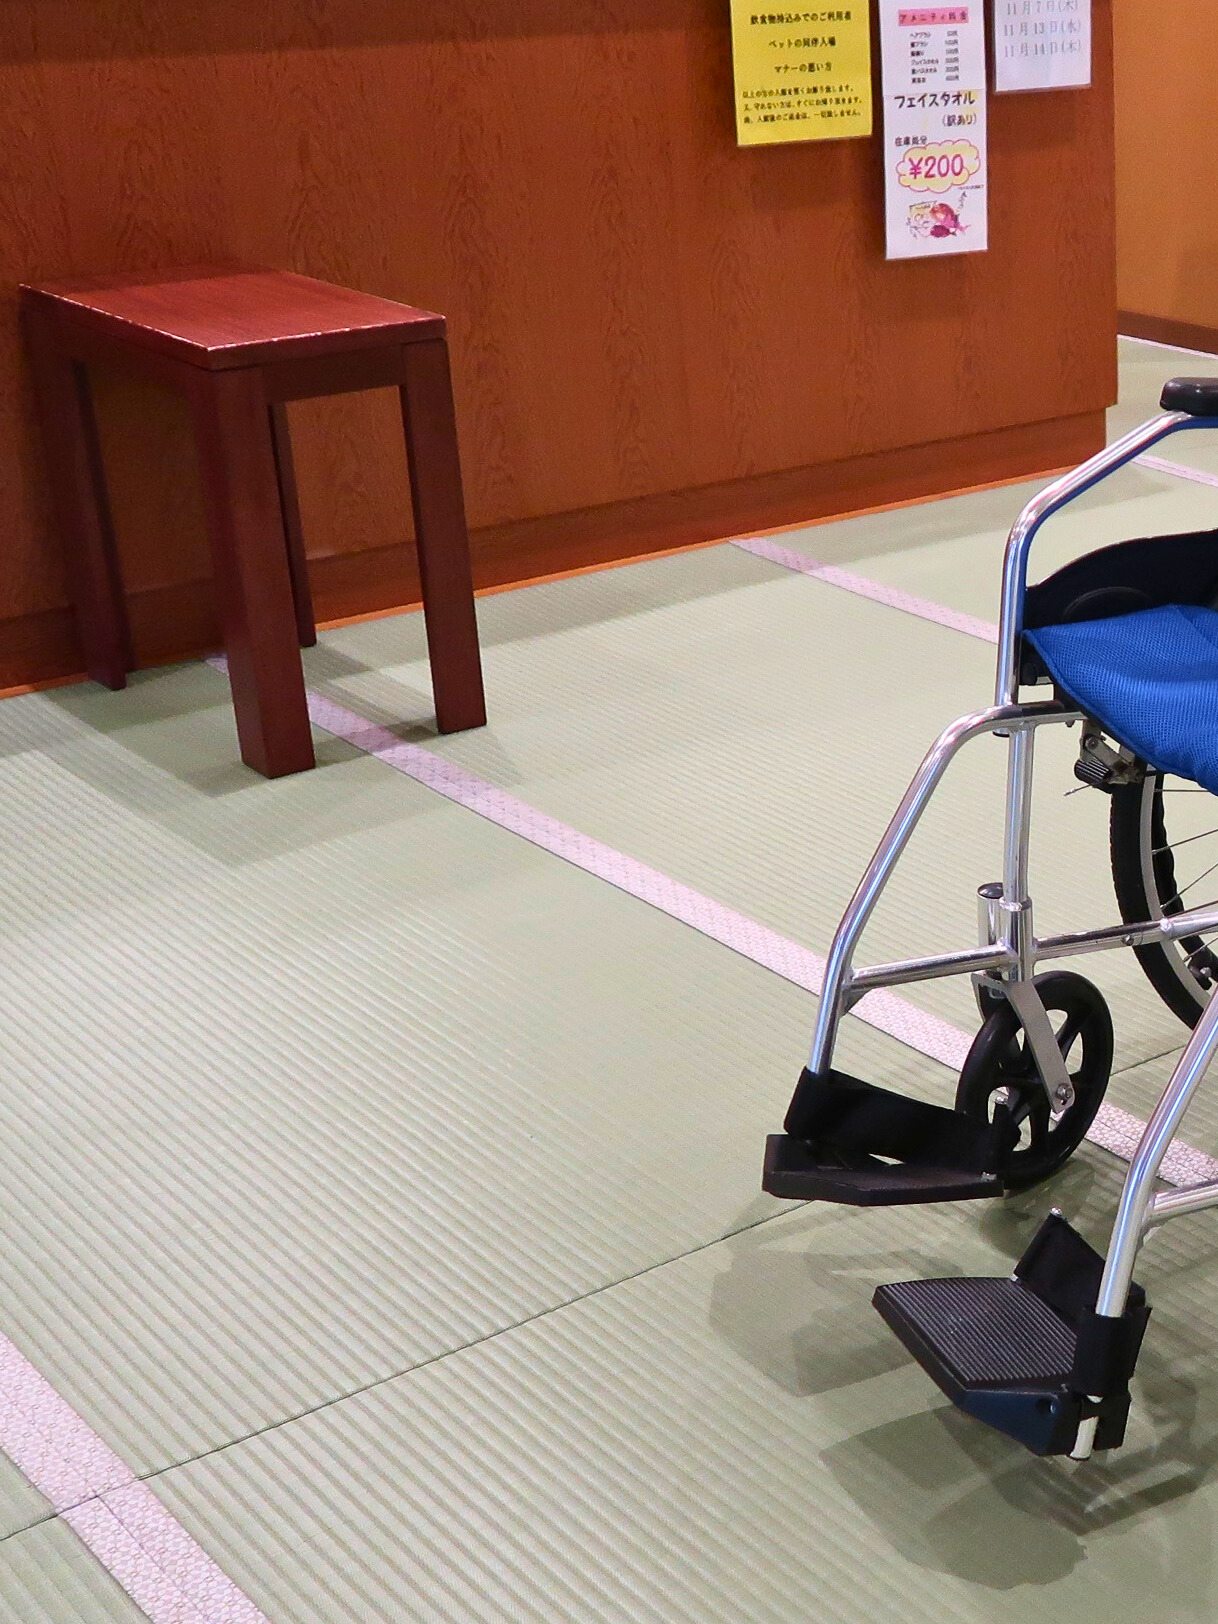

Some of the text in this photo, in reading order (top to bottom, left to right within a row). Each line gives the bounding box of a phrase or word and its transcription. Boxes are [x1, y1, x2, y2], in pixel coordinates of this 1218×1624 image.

[768, 36, 836, 48] ペットの同伴入場
[774, 62, 832, 74] マナーの悪い方
[894, 92, 976, 109] フェイスタオル
[908, 154, 964, 179] ¥200
